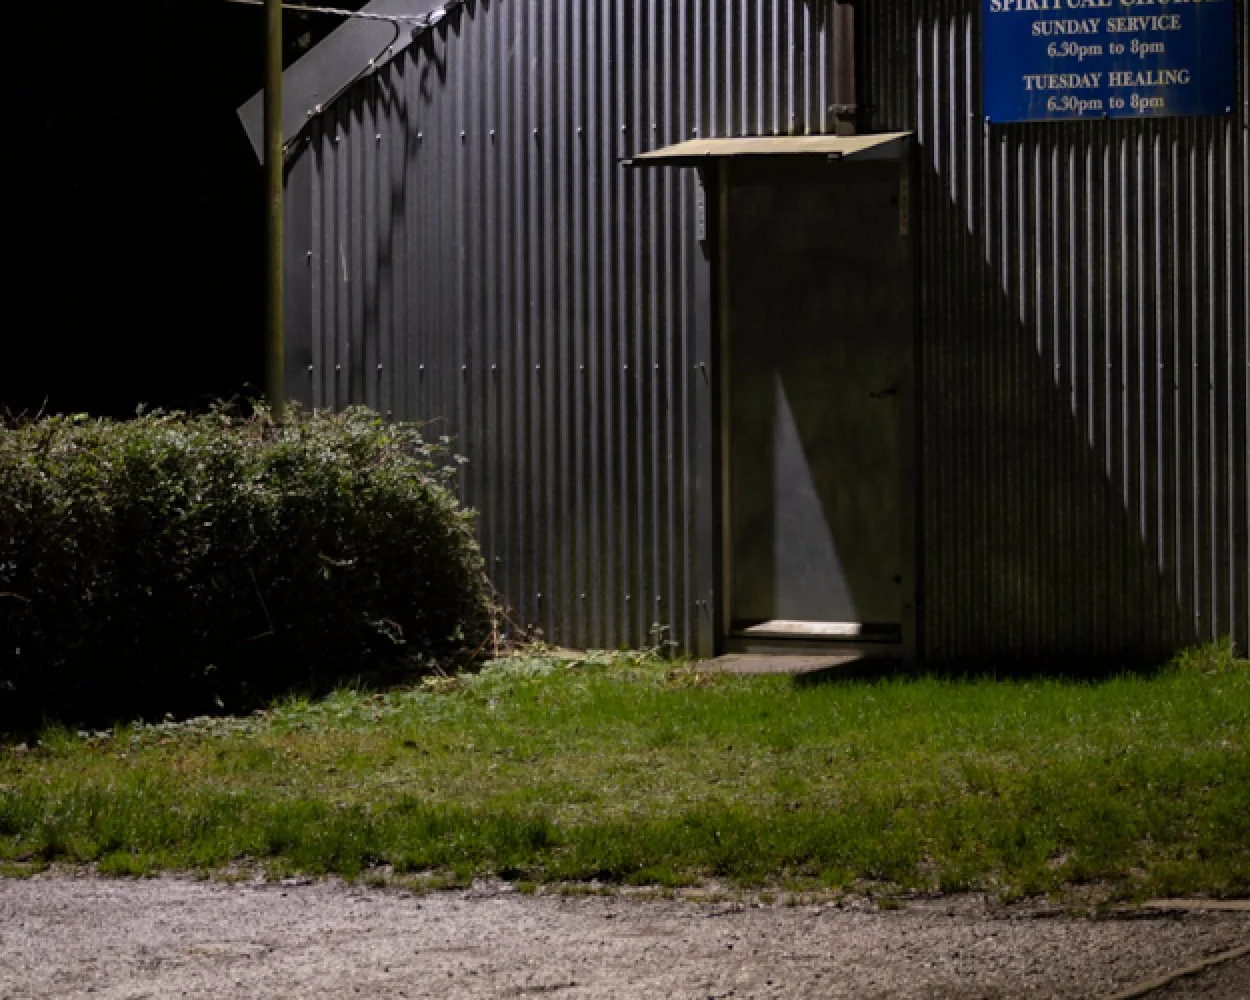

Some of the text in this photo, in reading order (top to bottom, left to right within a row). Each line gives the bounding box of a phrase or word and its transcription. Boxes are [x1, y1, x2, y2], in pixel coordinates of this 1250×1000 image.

[1031, 14, 1181, 36] SUNDAY SERVICE
[1047, 38, 1165, 62] 6.30pm to 8pm
[1023, 69, 1191, 90] TUESDAY HEALING
[1047, 92, 1165, 115] 6.30pm to 8pm
